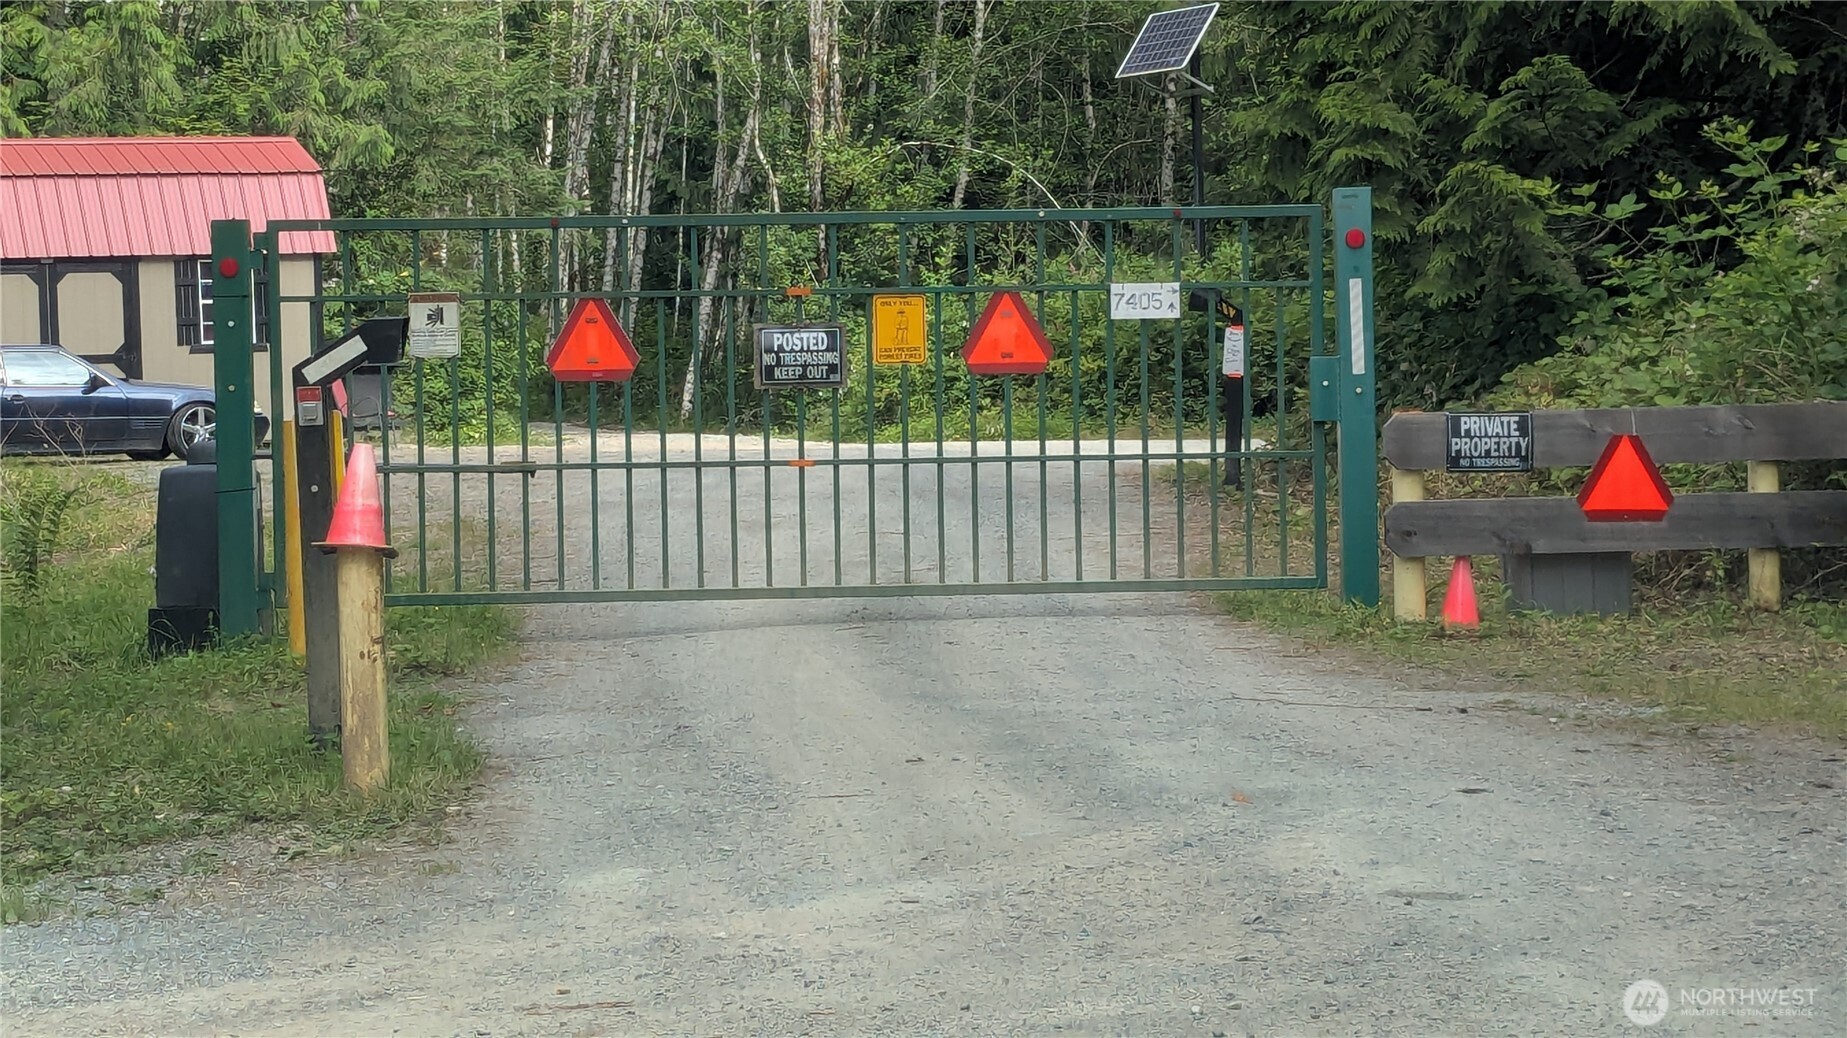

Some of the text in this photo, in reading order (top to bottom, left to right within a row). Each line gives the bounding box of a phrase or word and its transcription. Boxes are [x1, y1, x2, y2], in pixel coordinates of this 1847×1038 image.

[1113, 292, 1163, 311] 7405
[773, 332, 828, 351] POSTED
[764, 352, 839, 366] NO TRESPASSING
[774, 367, 803, 379] KEEP
[806, 366, 828, 379] OUT
[1460, 416, 1520, 436] PRIVATE
[1451, 437, 1529, 457] PROPERTY
[1460, 458, 1520, 467] NO TRESPASSING
